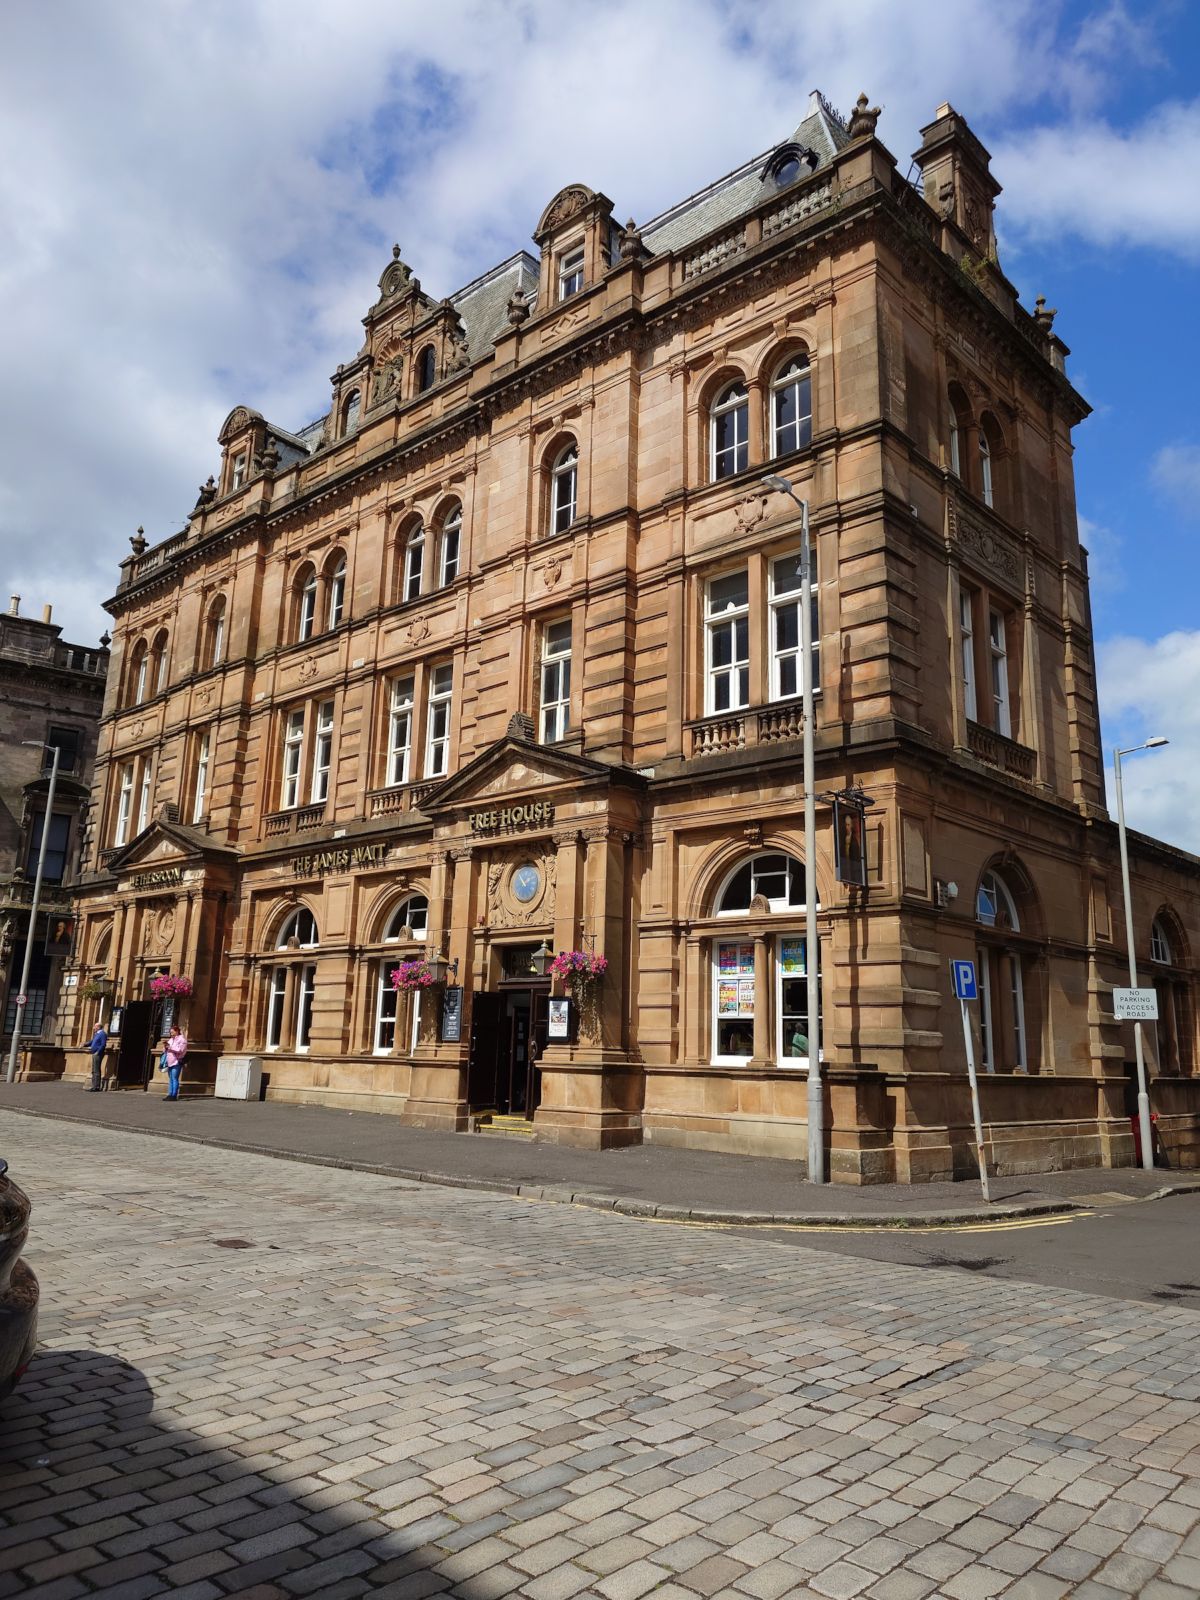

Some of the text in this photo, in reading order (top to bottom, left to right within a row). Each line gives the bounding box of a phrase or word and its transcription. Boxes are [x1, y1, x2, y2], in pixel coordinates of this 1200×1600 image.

[468, 801, 551, 831] FREE HOUSE
[289, 843, 386, 874] THE JAMES WATT
[959, 965, 973, 995] P
